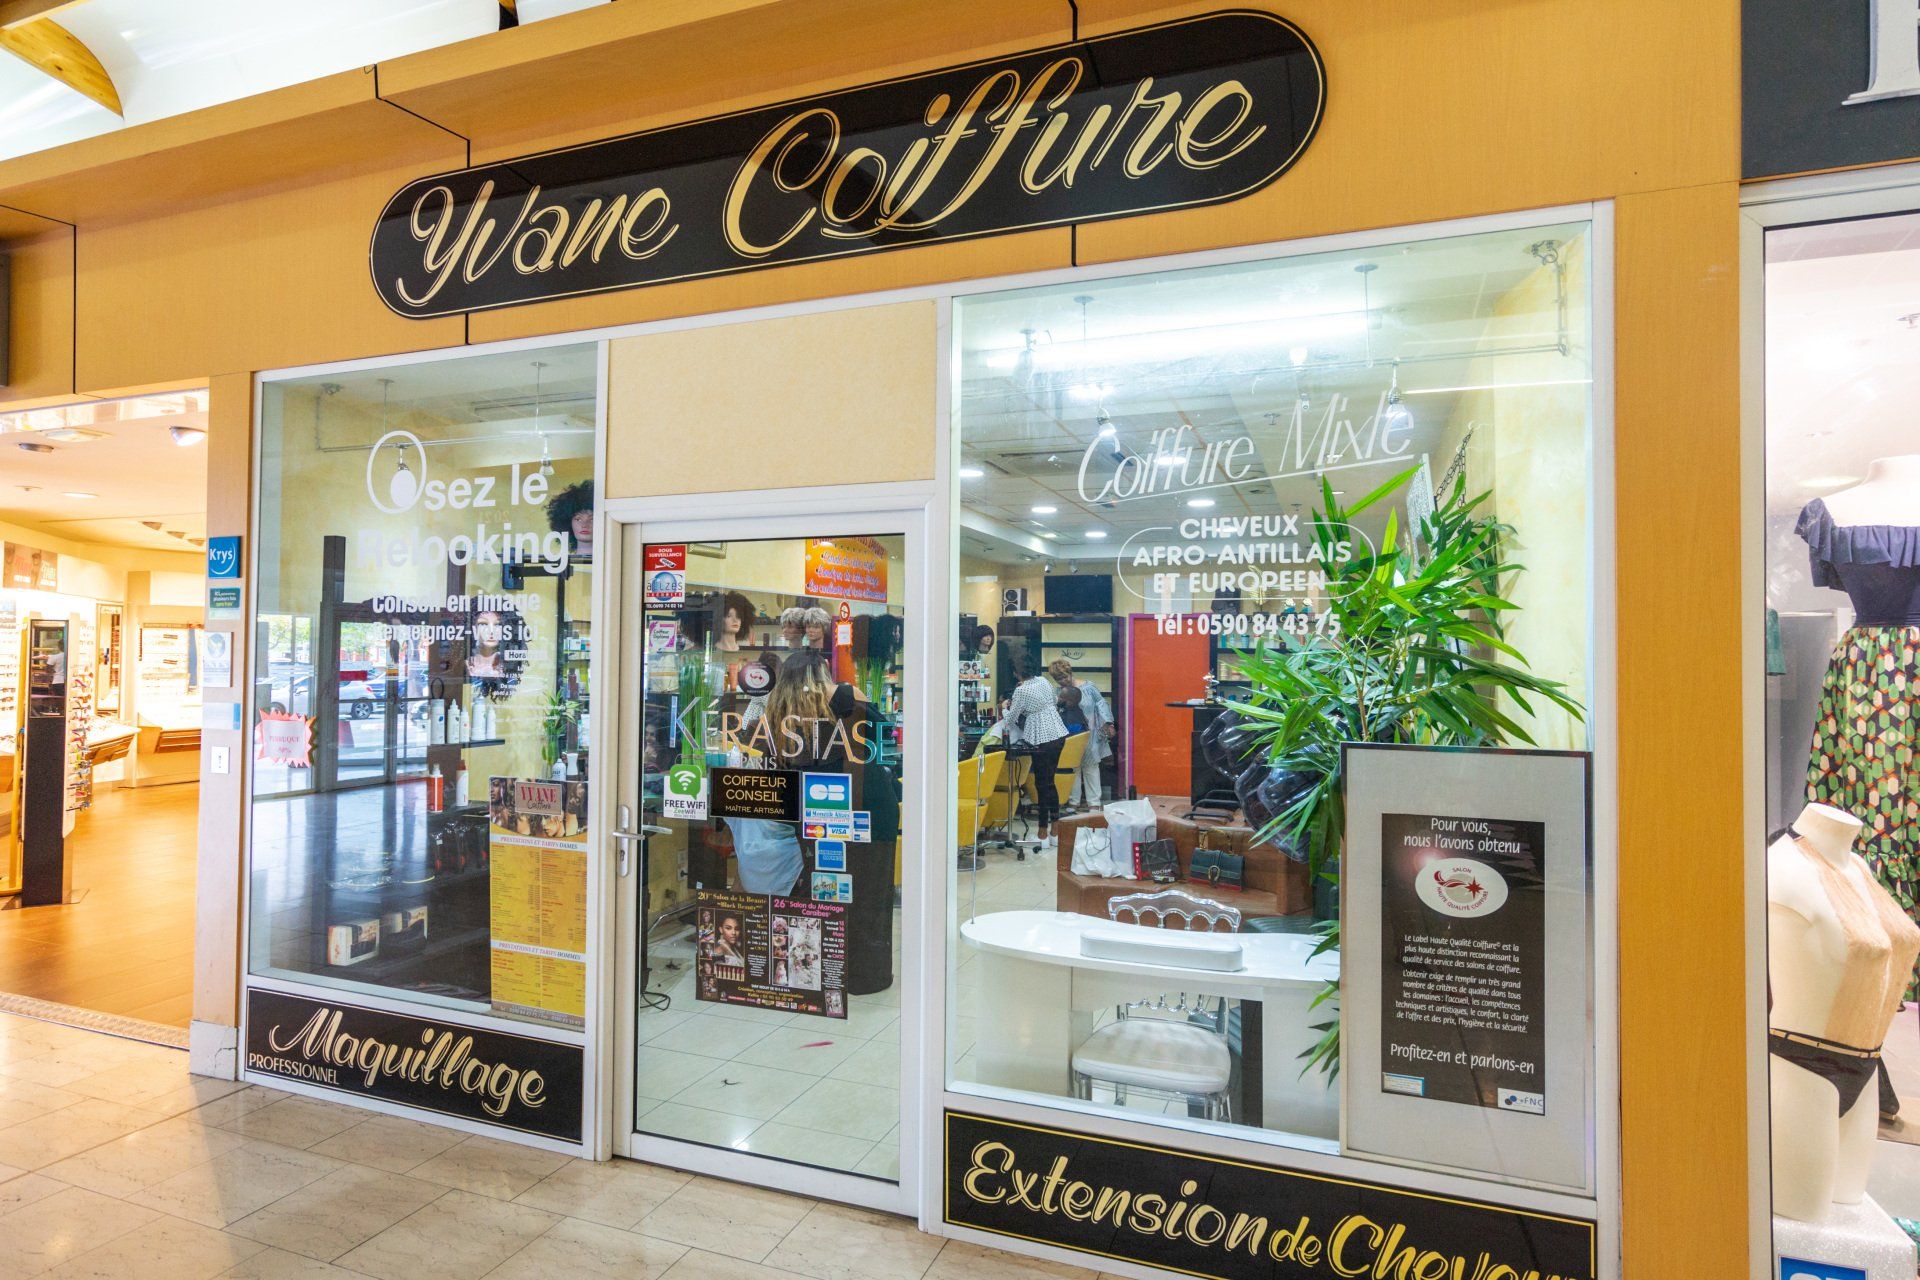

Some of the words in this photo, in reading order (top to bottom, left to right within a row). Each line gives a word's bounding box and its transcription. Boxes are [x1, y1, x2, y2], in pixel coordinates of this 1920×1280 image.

[397, 180, 680, 306] Yvane
[724, 56, 1269, 259] Coiffure
[367, 430, 496, 514] Osez
[511, 463, 549, 505] le
[1078, 425, 1254, 502] Coiffure
[1180, 514, 1298, 539] CHEVEUX
[209, 548, 233, 564] Krys
[356, 522, 569, 574] Relooking
[1132, 541, 1352, 567] AFRO-ANTILLAIS
[1153, 573, 1180, 593] ET
[1189, 570, 1326, 592] EUROPEEN
[446, 594, 470, 613] en
[477, 590, 541, 617] image
[1154, 613, 1182, 635] Tél
[1197, 613, 1248, 635] 0590
[1253, 613, 1278, 635] 84
[1283, 613, 1309, 635] 43
[1315, 613, 1341, 636] 75
[740, 756, 777, 770] PARIS
[723, 775, 787, 788] COIFFEUR
[664, 800, 685, 808] FREE
[726, 789, 783, 803] CONSEIL
[725, 805, 751, 813] MAÎTRE
[754, 807, 785, 815] ARTISAN
[1431, 818, 1459, 832] Pour
[1462, 821, 1491, 835] vous,
[1404, 834, 1431, 848] nous
[1434, 834, 1474, 851] l'avons
[1478, 838, 1521, 854] obtenu
[790, 901, 807, 909] Salon
[818, 904, 844, 913] Mariage
[1404, 945, 1417, 954] plus
[1418, 946, 1436, 955] haute
[1437, 948, 1468, 957] distinction
[1470, 951, 1511, 962] reconnaissant
[1513, 955, 1520, 963] la
[1413, 935, 1429, 943] Label
[1430, 937, 1448, 945] Haute
[1450, 938, 1472, 948] Qualité
[1513, 944, 1520, 952] la
[1402, 956, 1423, 964] qualité
[1434, 959, 1454, 967] service
[1454, 960, 1465, 968] des
[1466, 962, 1485, 970] salons
[1496, 964, 1521, 974] coiffure.
[1402, 969, 1428, 979] L'obtenir
[1429, 972, 1444, 981] exige
[1454, 976, 1477, 985] remplir
[1488, 978, 1500, 986] très
[1502, 980, 1521, 990] grand
[1402, 981, 1426, 990] nombre
[1436, 983, 1458, 992] critères
[1468, 987, 1490, 996] qualité
[1491, 989, 1507, 998] dans
[1508, 991, 1522, 1000] tous
[1403, 990, 1411, 998] les
[1412, 992, 1441, 1002] domaines
[1472, 997, 1480, 1006] les
[1482, 1000, 1521, 1011] compétences
[1396, 1000, 1427, 1012] techniques
[1470, 1008, 1476, 1016] le
[1510, 1013, 1529, 1023] clarté
[1396, 1011, 1404, 1019] de
[1405, 1012, 1423, 1022] l'offre
[1424, 1014, 1430, 1022] et
[1432, 1014, 1442, 1023] des
[1458, 1018, 1485, 1028] l'hygiène
[1486, 1021, 1493, 1029] et
[1494, 1022, 1500, 1030] la
[248, 1052, 340, 1086] PROFESSIONNEL
[269, 1008, 546, 1116] Maquillage
[1390, 1043, 1451, 1063] Profitez-en
[1455, 1052, 1468, 1065] et
[1470, 1052, 1535, 1074] parlons-en
[963, 1140, 1275, 1254] Extension
[1268, 1216, 1322, 1268] de
[1327, 1214, 1577, 1280] Chev
